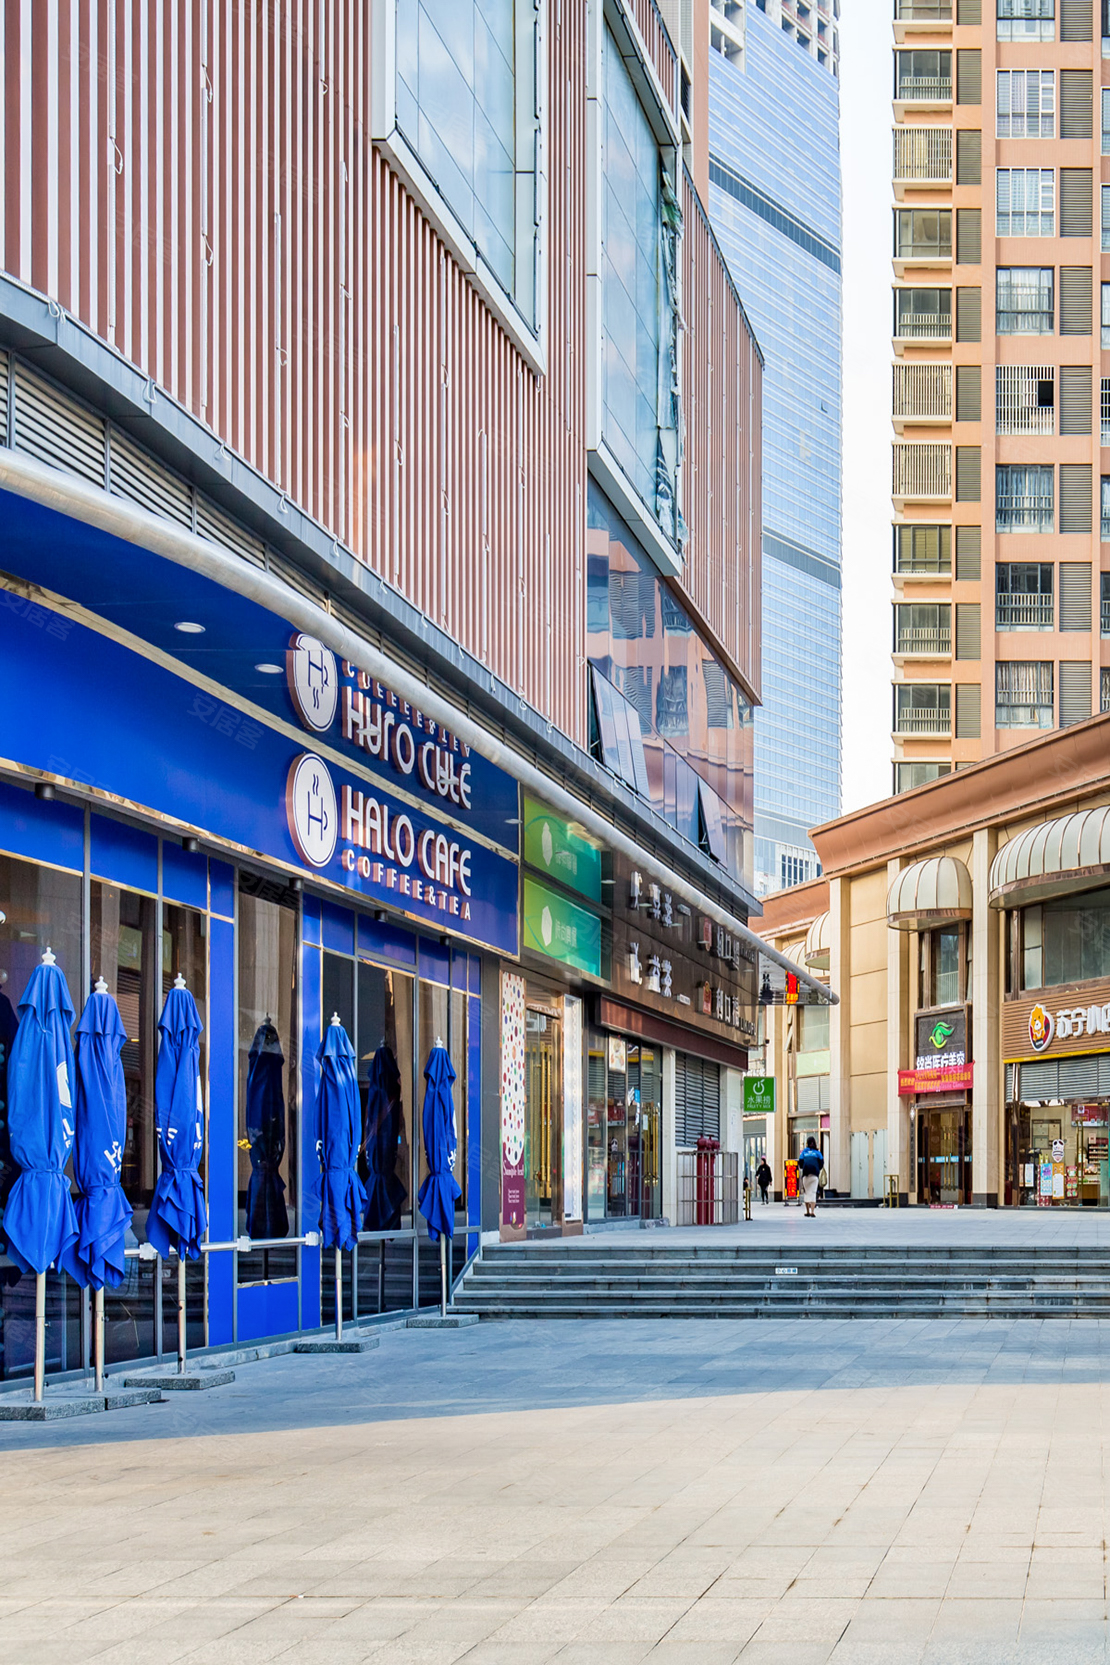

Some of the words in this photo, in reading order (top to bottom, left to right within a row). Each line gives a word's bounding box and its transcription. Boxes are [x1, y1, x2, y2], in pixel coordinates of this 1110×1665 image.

[341, 785, 415, 868] HALO
[417, 829, 472, 897] CAFE
[341, 849, 472, 922] COFFEE&TEA
